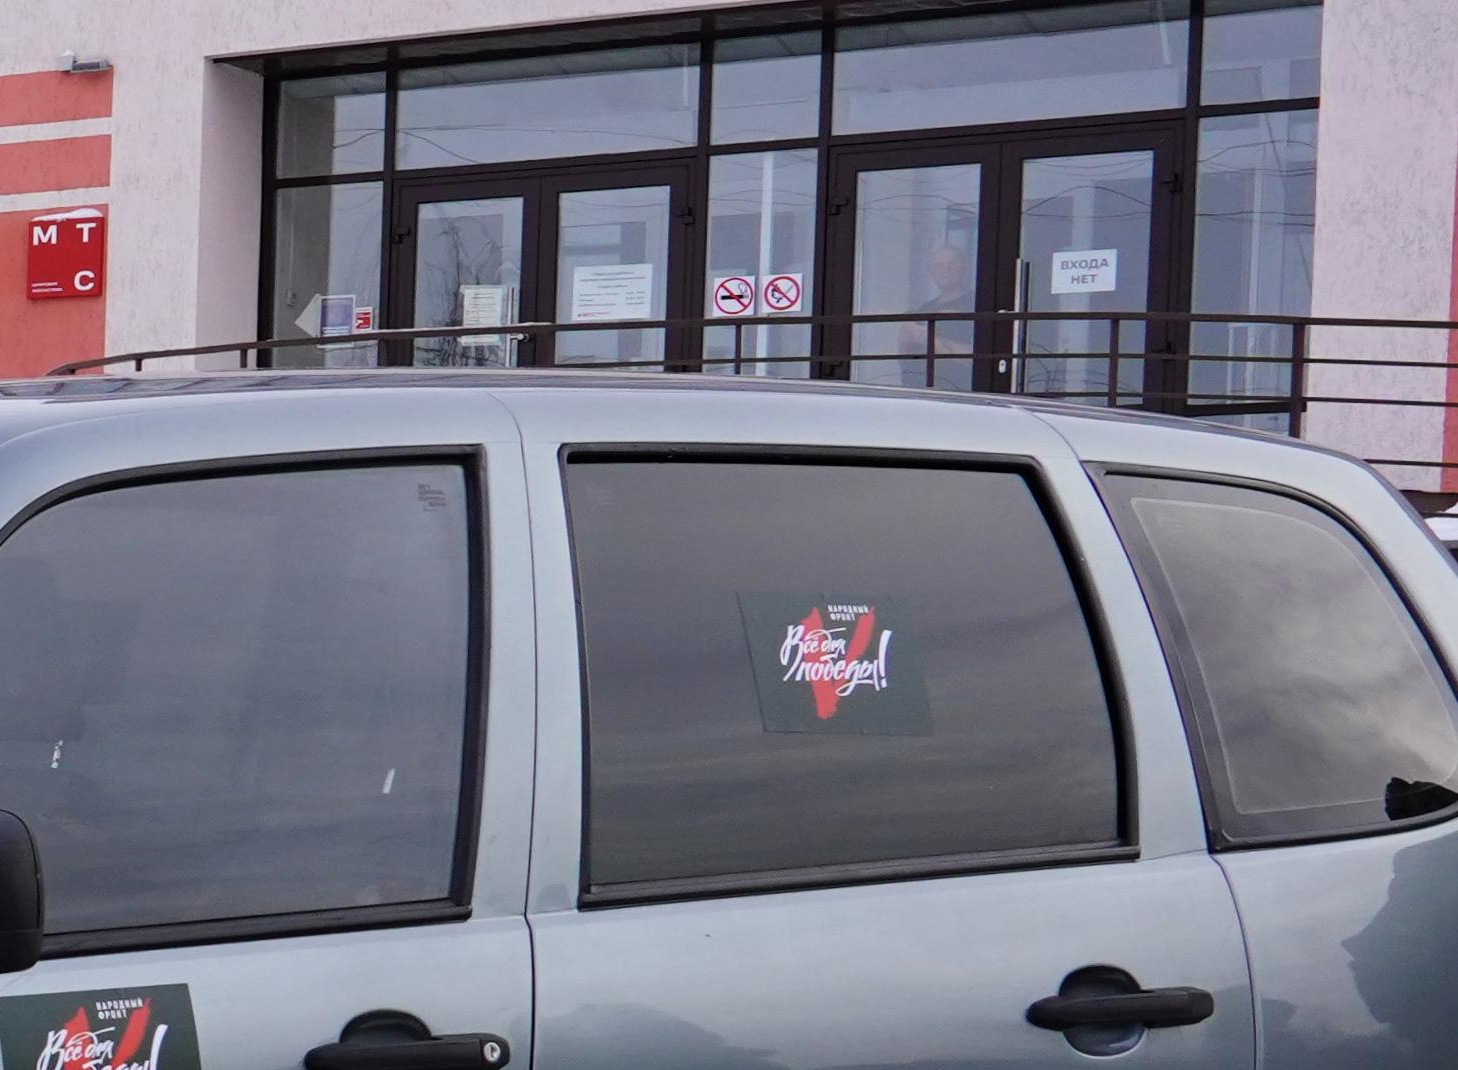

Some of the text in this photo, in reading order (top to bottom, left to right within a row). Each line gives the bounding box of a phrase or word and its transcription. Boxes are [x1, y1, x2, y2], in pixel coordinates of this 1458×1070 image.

[1060, 258, 1109, 270] ВХОДА
[1071, 273, 1098, 285] НЕТ
[95, 997, 144, 1011] НАРОДНЫЙ
